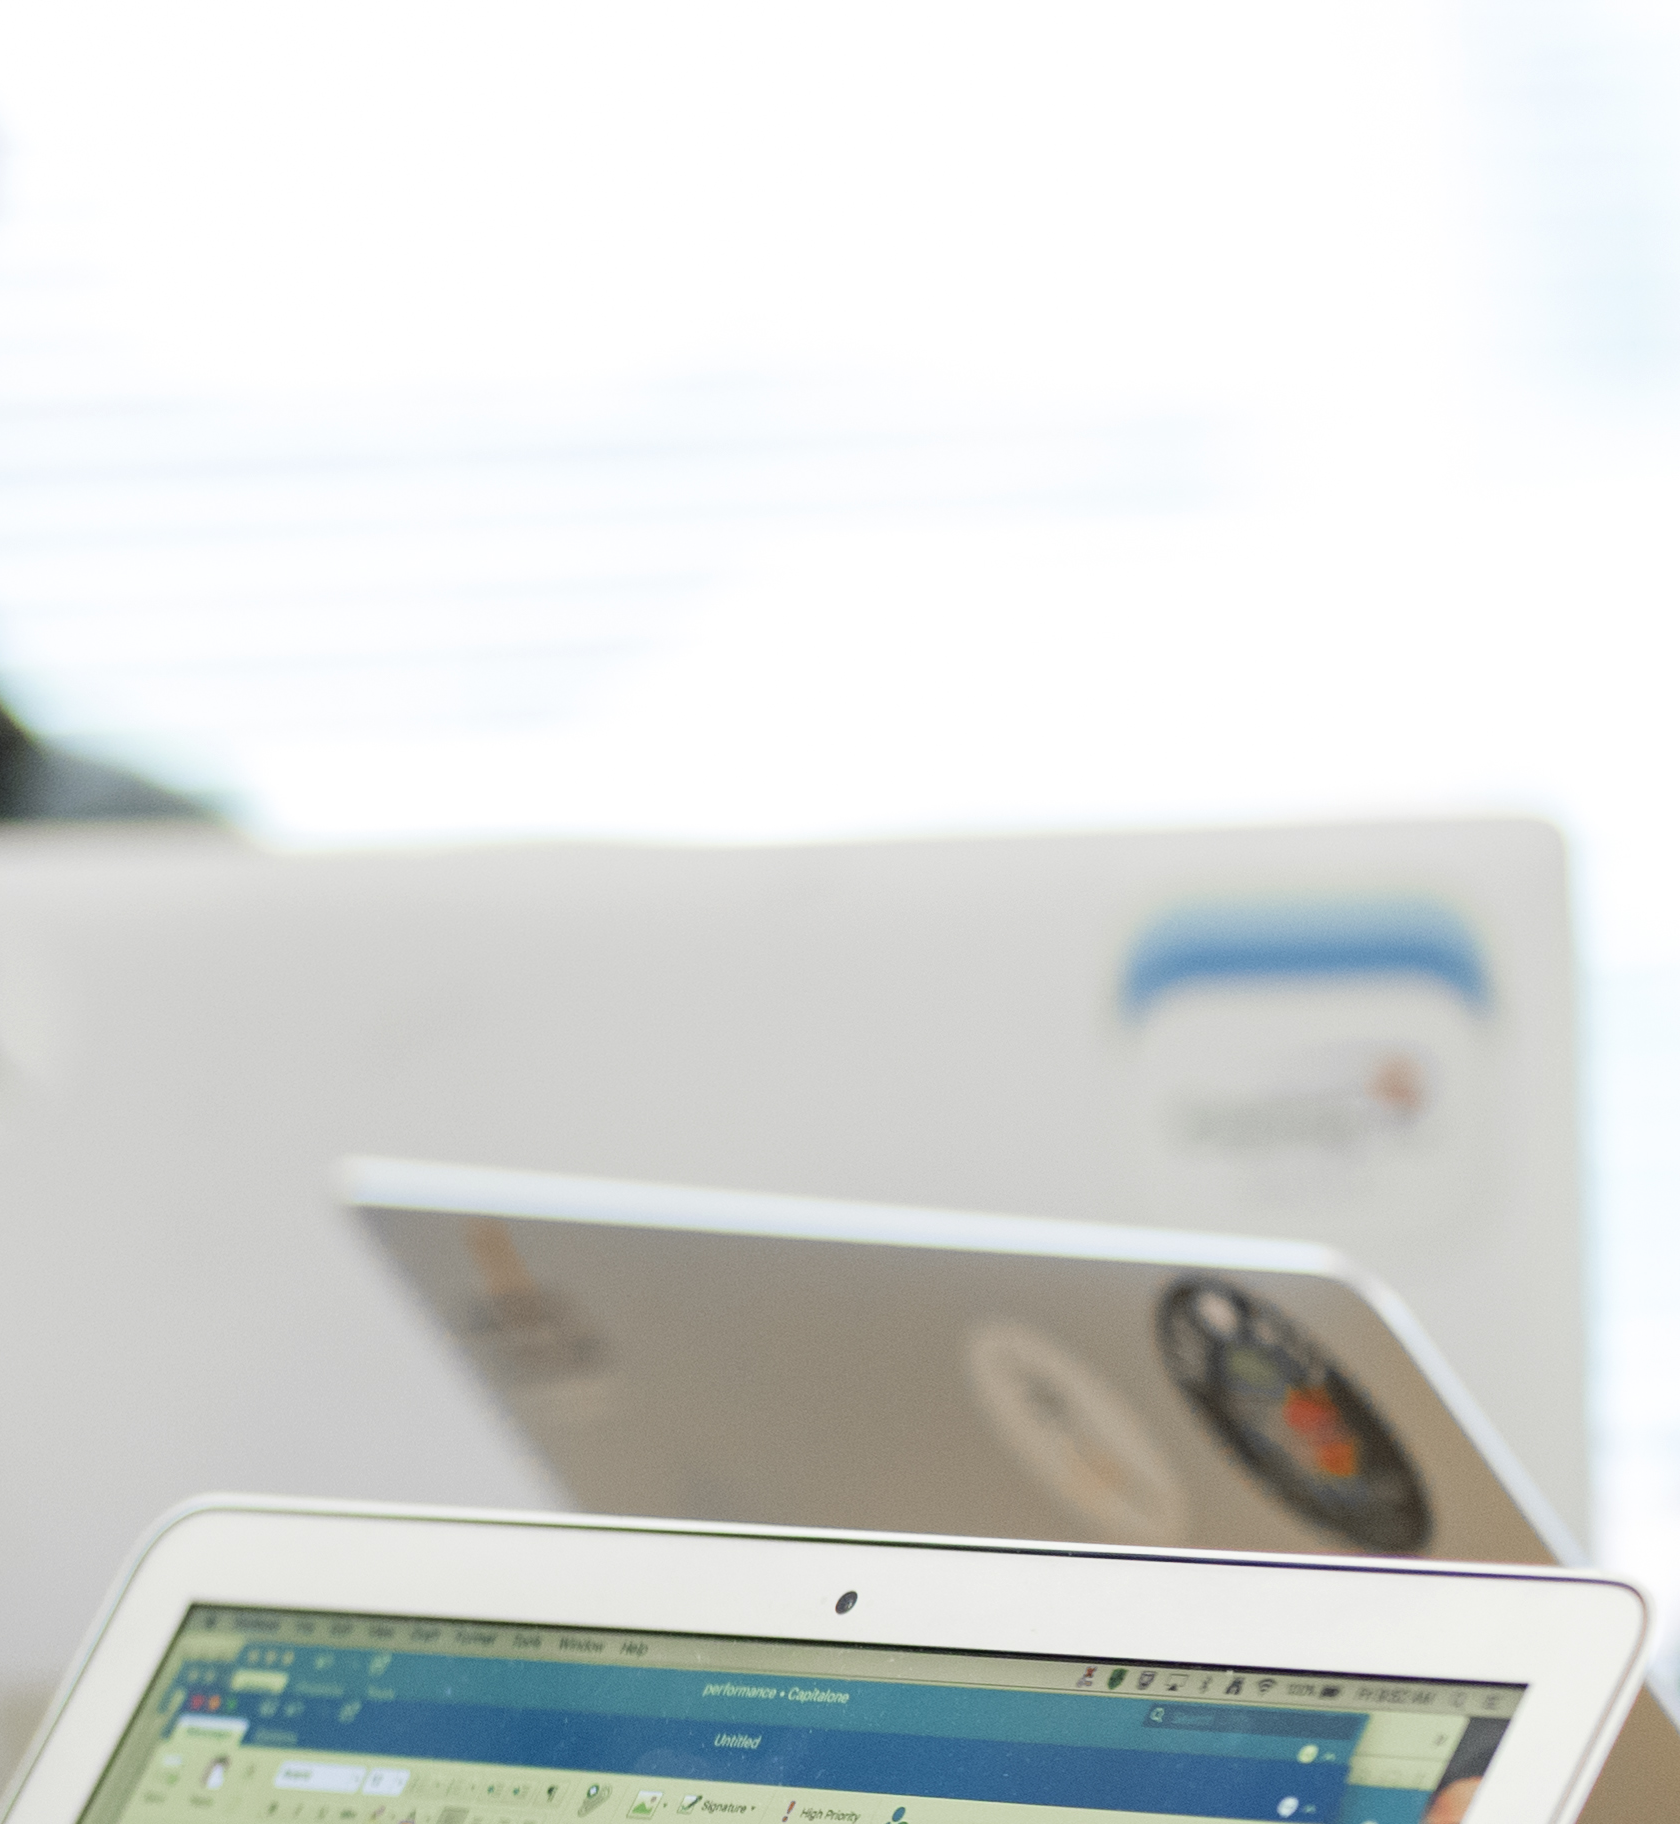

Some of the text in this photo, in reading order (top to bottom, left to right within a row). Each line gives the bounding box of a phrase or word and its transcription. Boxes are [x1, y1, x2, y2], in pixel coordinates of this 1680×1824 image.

[558, 1636, 605, 1654] Window
[620, 1641, 649, 1657] Help
[702, 1682, 850, 1704] performance Capitalone
[713, 1733, 762, 1750] Untitled
[700, 1801, 747, 1815] Signature
[799, 1807, 861, 1824] High Priority
